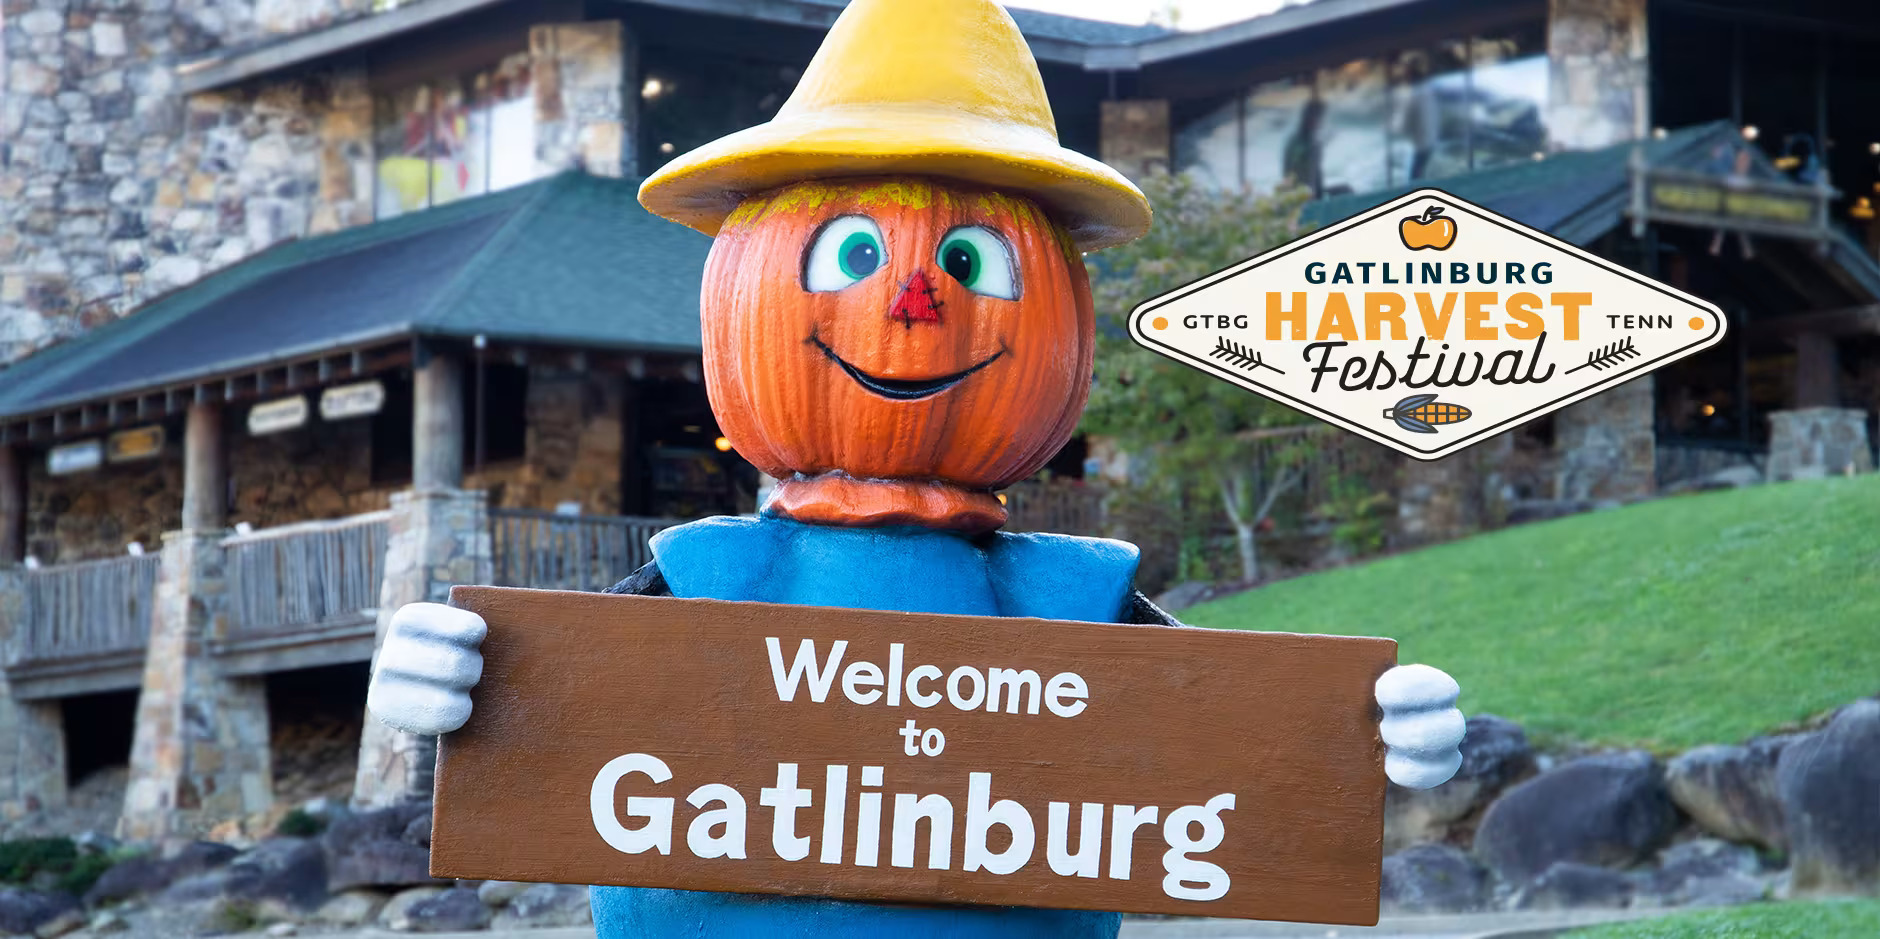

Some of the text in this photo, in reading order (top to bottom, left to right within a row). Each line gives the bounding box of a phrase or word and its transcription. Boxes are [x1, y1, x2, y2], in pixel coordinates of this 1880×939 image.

[765, 637, 1090, 718] Welcome
[899, 720, 946, 757] to
[590, 752, 1236, 901] Gatlinburg
